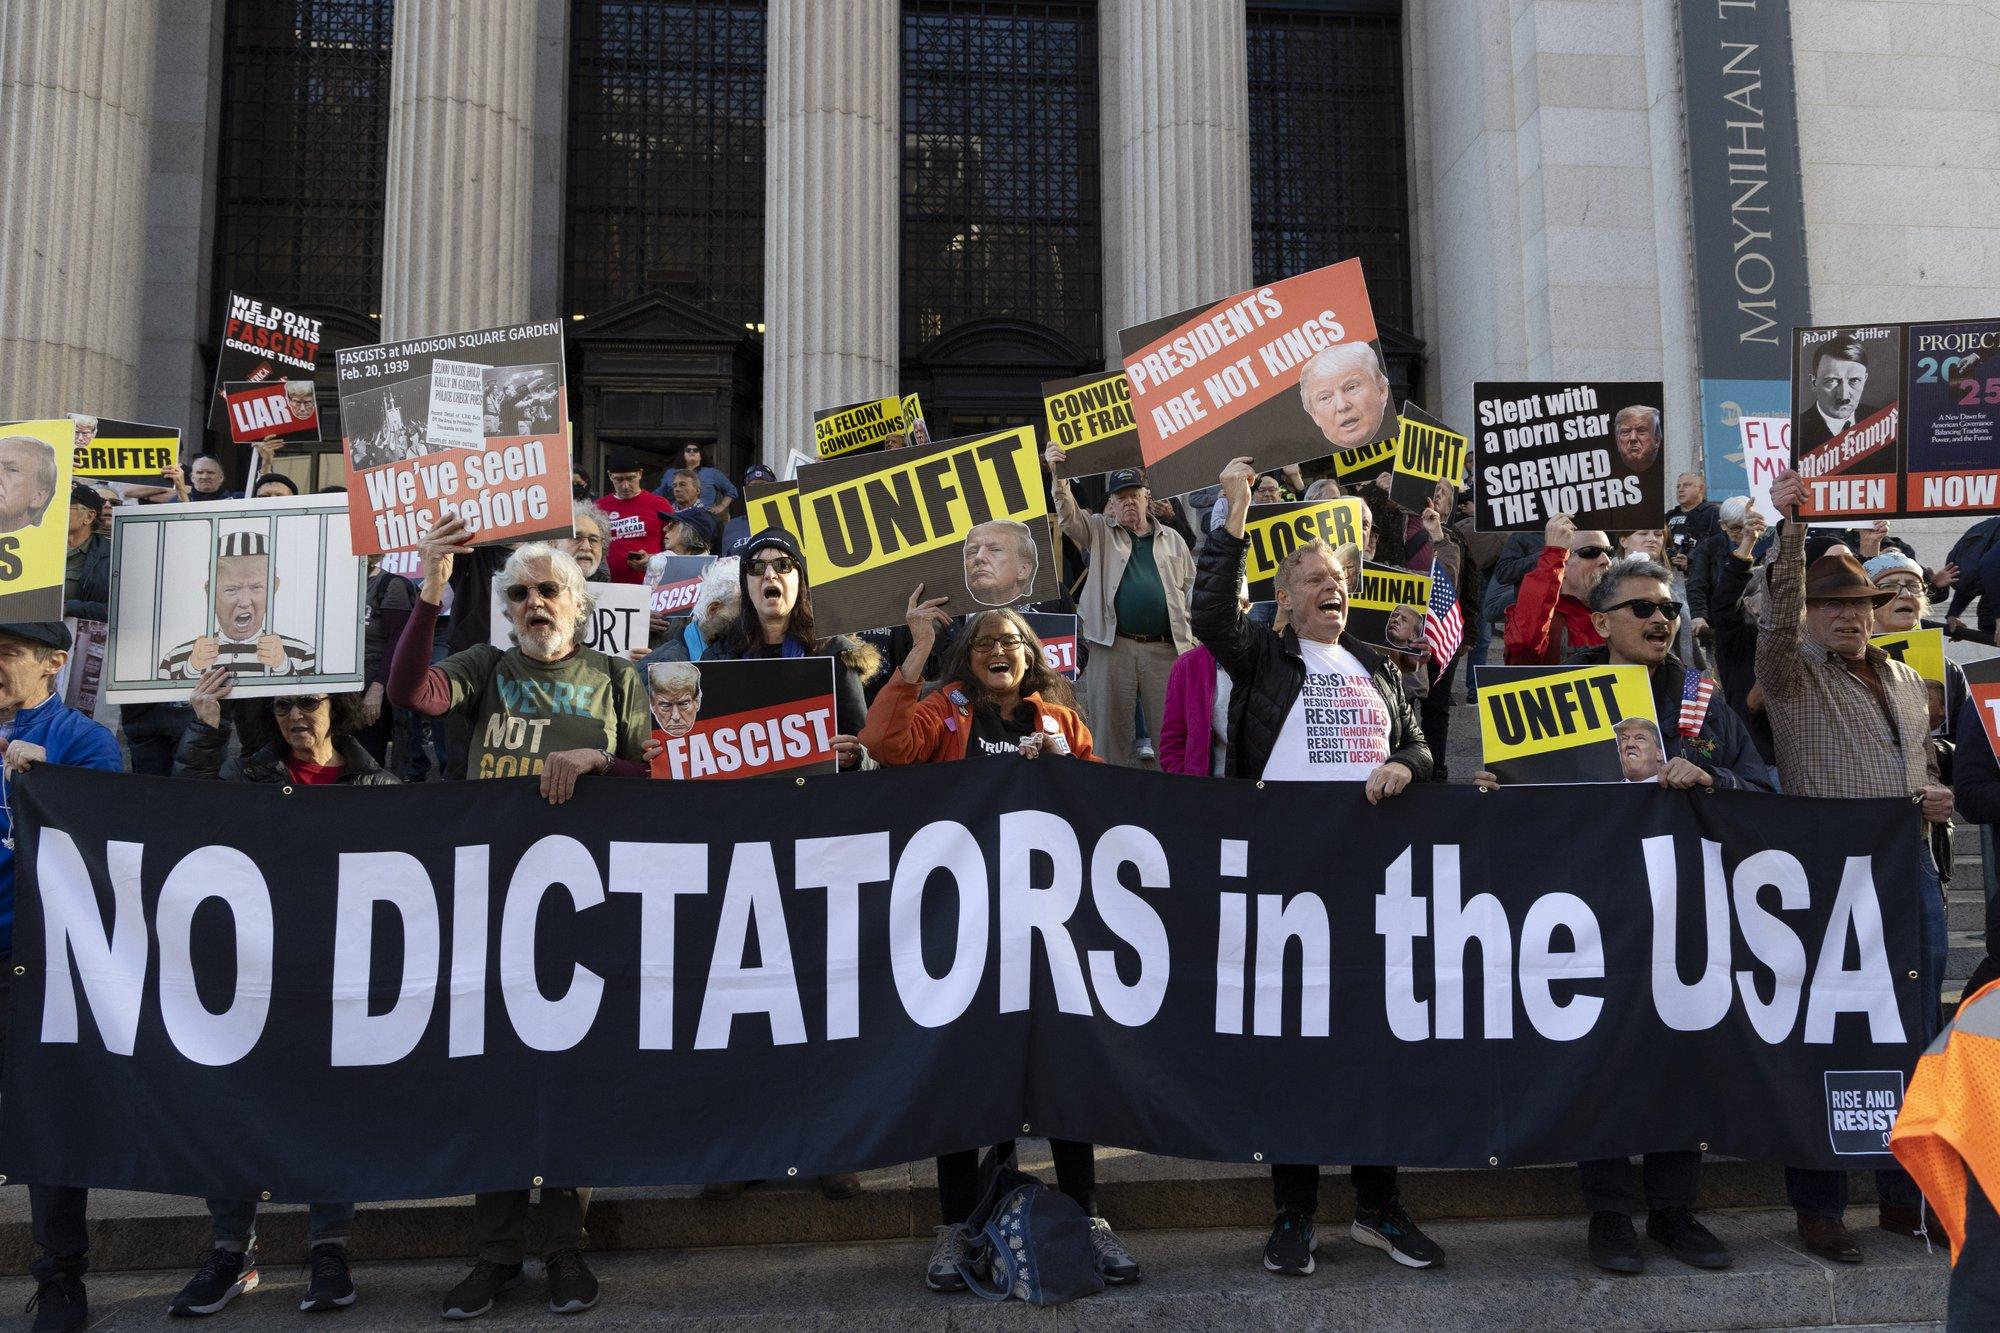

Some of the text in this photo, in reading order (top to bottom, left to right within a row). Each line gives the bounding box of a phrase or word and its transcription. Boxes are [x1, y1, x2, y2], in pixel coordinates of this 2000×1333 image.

[1720, 40, 1779, 346] MOYNIHAN
[230, 307, 321, 344] NEED THIS
[233, 294, 322, 333] WE DONT
[226, 318, 320, 362] FASCIST
[339, 322, 559, 365] FASCISTS at MADISON SQUARE GARDEN
[1126, 287, 1283, 396] PRESIDENTS
[1849, 328, 1890, 342] Hitler
[225, 338, 316, 372] GROOVE THANG
[341, 359, 409, 381] Feb. 20, 1939
[1151, 309, 1345, 440] ARE NOT KINGS
[232, 394, 292, 433] LIAR
[1050, 378, 1131, 422] CONVIC
[1478, 385, 1598, 427] Slept with
[815, 403, 884, 439] 34 FELONY
[819, 415, 905, 455] CONVICTIONS
[1057, 418, 1084, 446] OF
[1483, 413, 1610, 454] a porn star
[1934, 428, 1961, 436] Balancing
[1959, 420, 1994, 428] Governance
[73, 447, 172, 470] GRIFTER
[463, 439, 547, 490] seen
[1402, 423, 1464, 480] UNFIT
[1799, 443, 1841, 478] Mein
[1483, 448, 1612, 496] SCREWED
[1923, 474, 1998, 508] NOW
[812, 434, 1029, 568] UNFIT
[1487, 475, 1643, 527] THE VOTERS
[1810, 478, 1886, 511] THEN
[375, 504, 433, 550] this
[625, 524, 644, 533] SCAB
[1250, 505, 1356, 572] LOSER
[1349, 575, 1427, 605] MINAL
[496, 674, 595, 718] WE'RE
[1302, 686, 1339, 697] RESIST
[1304, 672, 1346, 687] RESIST
[1303, 698, 1334, 707] RESIST
[1305, 708, 1388, 726] RESIST LIES
[1487, 673, 1624, 746] UNFIT
[483, 713, 550, 754] NOT
[666, 708, 831, 780] FASCIST
[1307, 726, 1340, 736] RESIST
[1307, 738, 1344, 749] RESIST
[1309, 751, 1348, 763] RESIST
[36, 809, 1908, 1067] NO DICTATORS in the USA
[1831, 1090, 1895, 1108] RISE AND
[1833, 1109, 1898, 1131] RESIST
